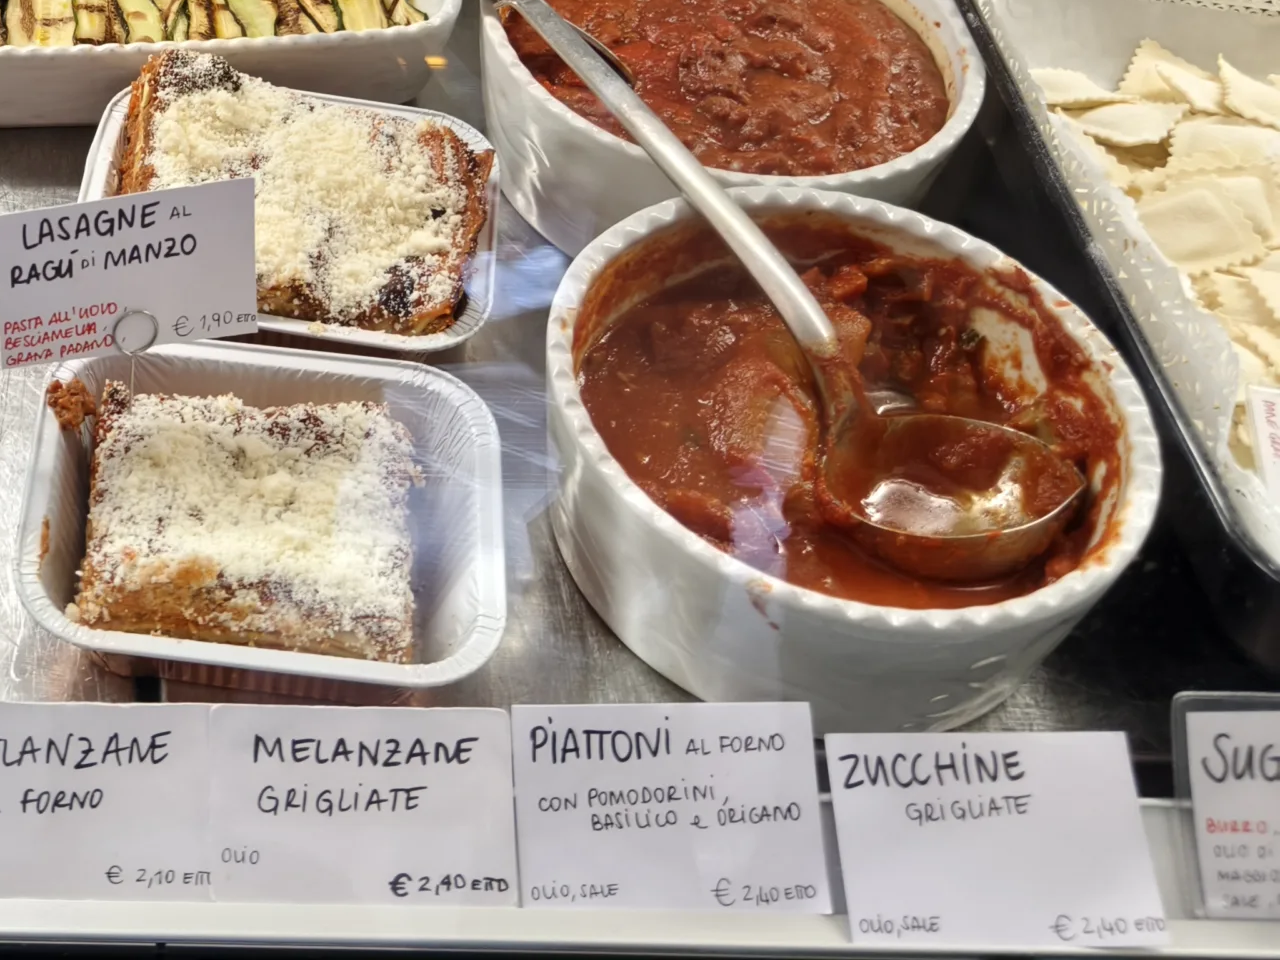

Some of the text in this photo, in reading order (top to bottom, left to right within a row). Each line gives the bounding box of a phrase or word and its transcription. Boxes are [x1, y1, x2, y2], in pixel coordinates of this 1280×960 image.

[21, 200, 193, 251] LASAGNE AL
[103, 233, 198, 271] MANZO
[4, 316, 45, 336] PASTA
[199, 309, 234, 334] 1,90
[236, 312, 258, 324] ETTO
[5, 349, 54, 368] GRANA
[252, 733, 480, 768] MELANZANE
[529, 715, 785, 765] PIATTONI AL FORNO
[838, 741, 1025, 790] ZUCCHINE
[20, 788, 104, 815] FORNO
[257, 783, 429, 817] GRIGLIATE
[538, 792, 578, 812] CON
[905, 794, 1032, 827] GRIGLIATE
[591, 807, 678, 831] BASILICO
[220, 845, 261, 865] OLIO
[135, 868, 176, 889] 2,10
[418, 874, 467, 896] 2,40
[471, 876, 510, 893] ETTO
[742, 884, 780, 907] 2,40
[784, 884, 817, 900] ETTO
[1081, 916, 1128, 937] 2,40
